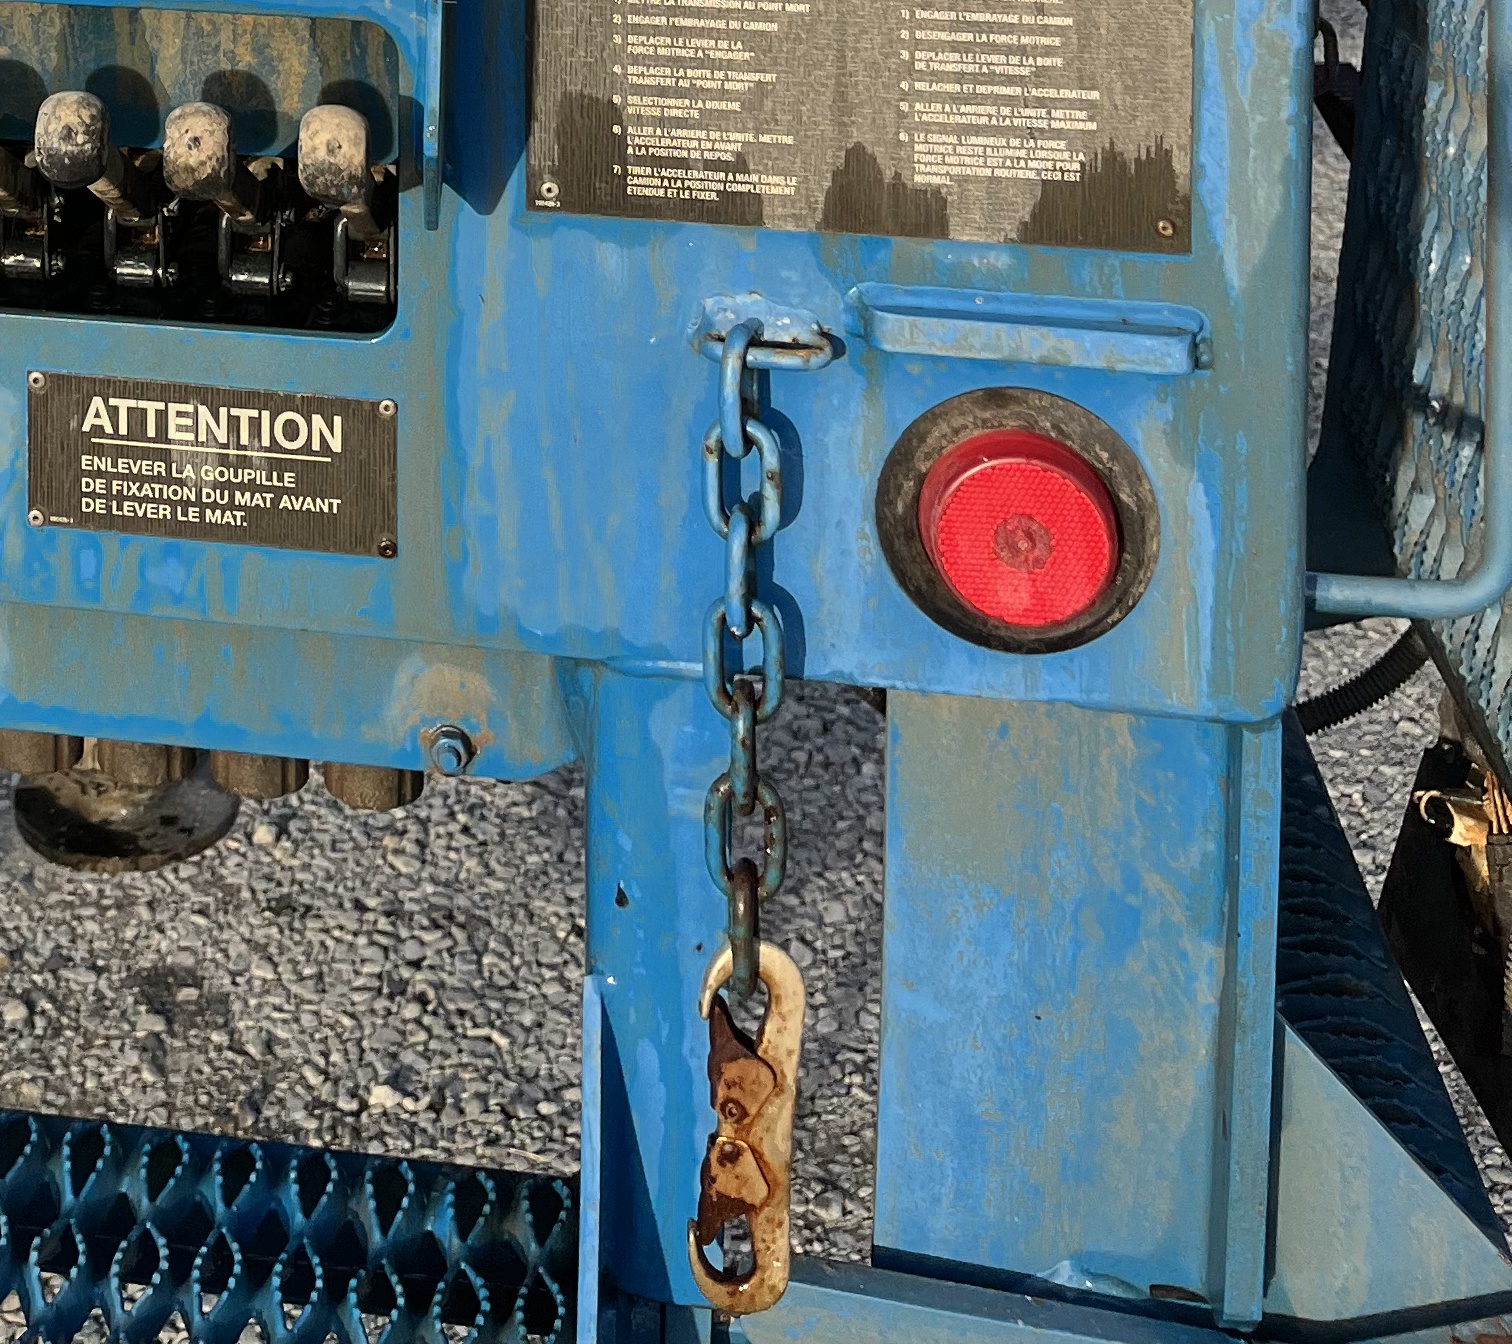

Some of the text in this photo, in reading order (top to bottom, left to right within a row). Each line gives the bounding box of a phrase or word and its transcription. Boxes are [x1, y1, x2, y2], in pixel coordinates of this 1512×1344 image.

[743, 0, 755, 11] AU
[757, 1, 783, 12] POINT
[784, 2, 810, 13] MORT
[899, 81, 1100, 100] 4) RELACHER ET DEPRIMER L'ACCELERATEUR
[914, 112, 1097, 131] L'ACCELERATEUR A LA VITESSE MAXIMUM
[81, 396, 341, 454] ATTENTION
[81, 457, 295, 488] ENLEVER LA GOUPILLE
[81, 477, 339, 513] DE FIXATION DU MAT AVANT
[81, 498, 247, 526] DE LEVER LE MAT.
